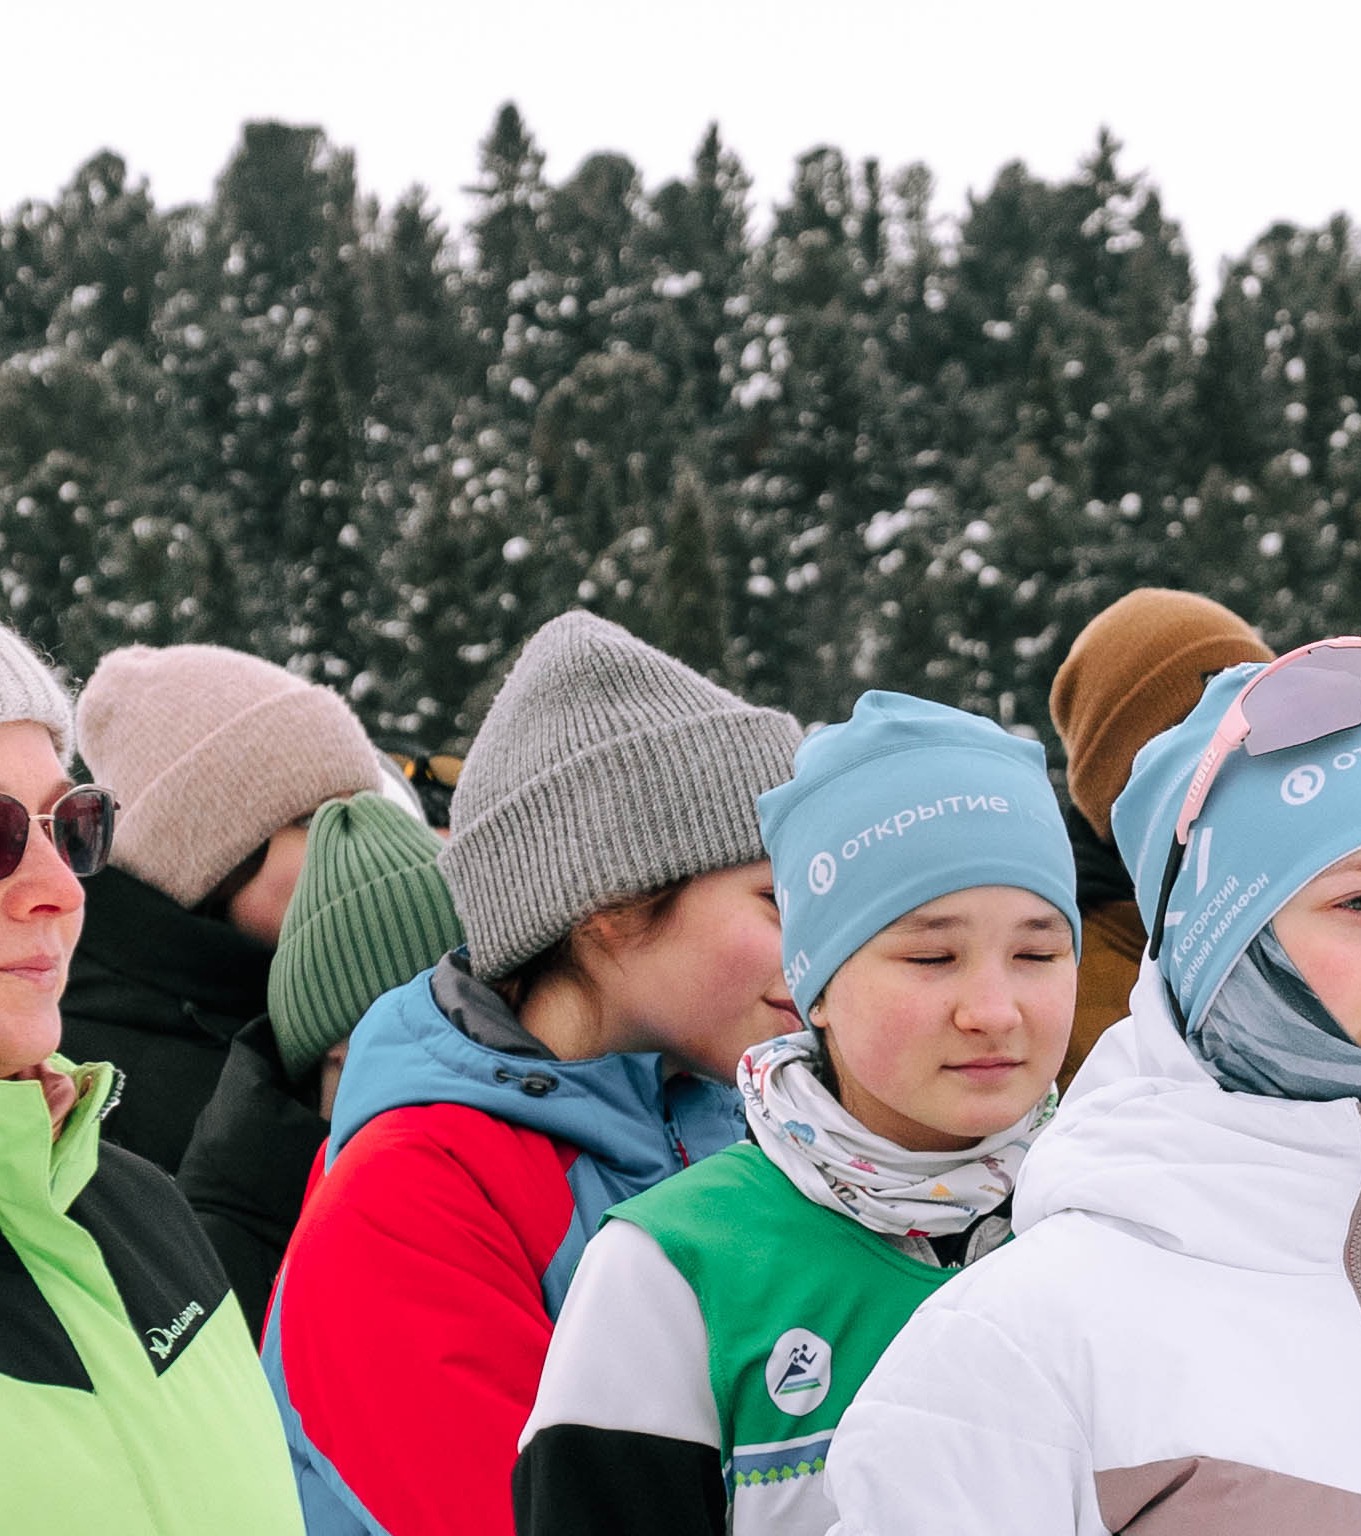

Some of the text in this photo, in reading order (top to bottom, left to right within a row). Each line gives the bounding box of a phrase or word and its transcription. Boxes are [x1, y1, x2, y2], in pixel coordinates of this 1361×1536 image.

[842, 794, 1010, 860] открытие
[1179, 874, 1240, 955] ЮГОРСКИЙ
[1210, 872, 1270, 944] МАРАФОН
